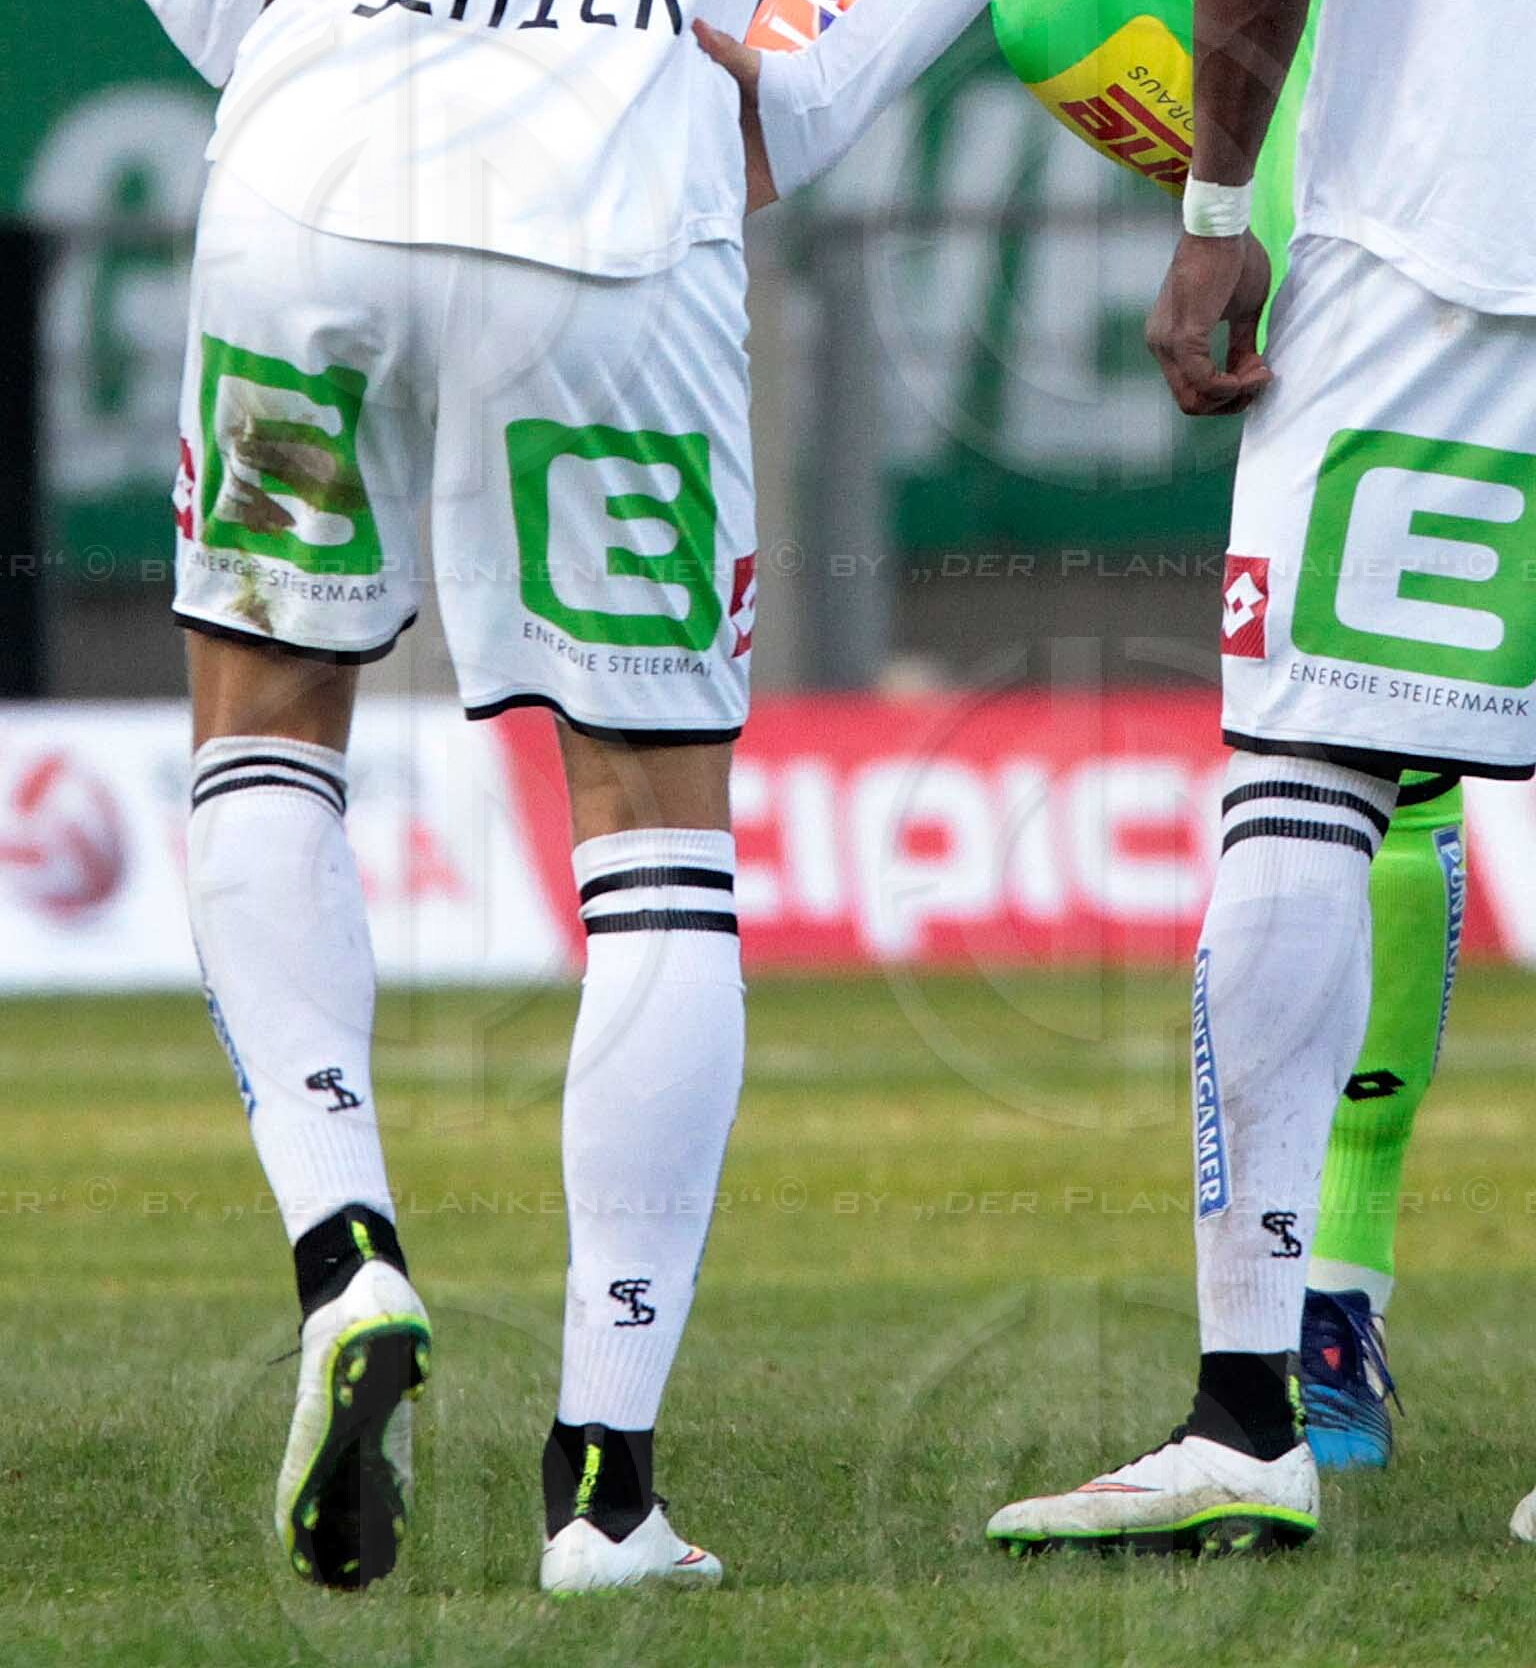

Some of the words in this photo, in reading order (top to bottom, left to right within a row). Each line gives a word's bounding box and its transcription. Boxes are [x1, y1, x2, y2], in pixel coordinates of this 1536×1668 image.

[1334, 466, 1525, 651] E
[523, 622, 598, 672] ENERGIE
[607, 655, 712, 678] STEIERMA
[1289, 662, 1378, 694] ENERGIE
[1388, 679, 1529, 717] STEIERMARK
[1194, 964, 1225, 1206] PUNTIGAMER
